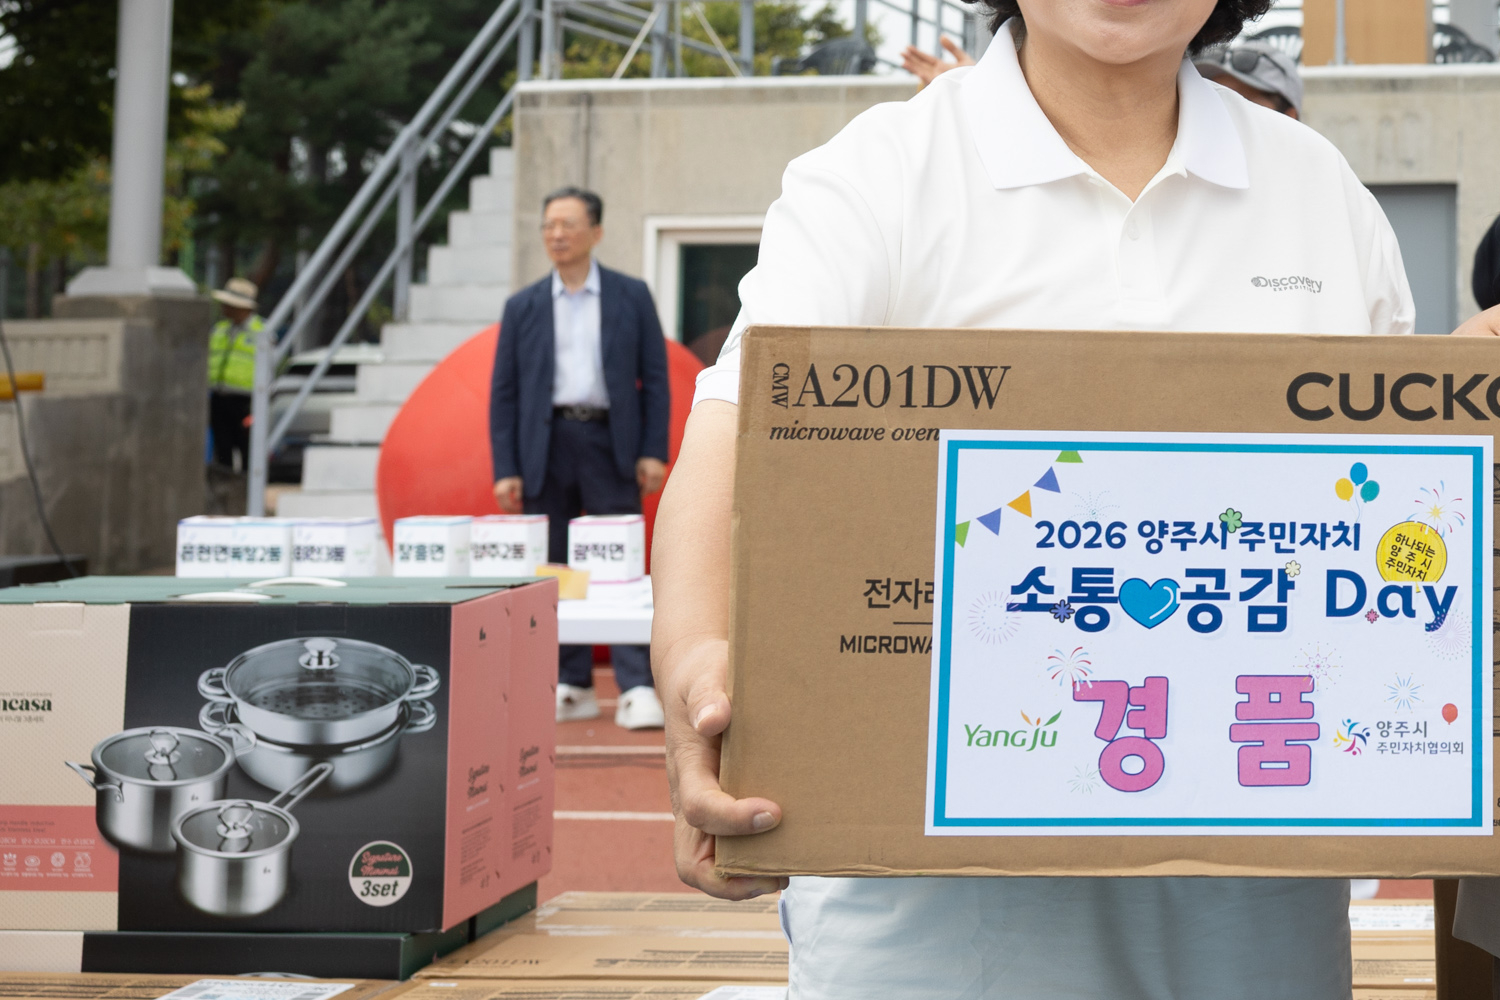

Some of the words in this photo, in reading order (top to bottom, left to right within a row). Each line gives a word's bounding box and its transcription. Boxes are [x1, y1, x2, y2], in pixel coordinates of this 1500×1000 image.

[770, 362, 791, 410] CMW
[791, 362, 1012, 410] A201DW
[769, 420, 886, 442] microwave
[891, 426, 941, 442] oven
[1034, 520, 1127, 550] 2026
[1137, 518, 1230, 555] 양주시
[1238, 521, 1362, 553] 주민자치
[1394, 532, 1436, 559] 하나되는
[1385, 557, 1428, 582] 주민자치
[1006, 565, 1120, 633] 소통
[1179, 567, 1296, 634] 공감
[1326, 569, 1459, 633] Day
[1375, 720, 1428, 738] 양주시
[1375, 741, 1464, 755] 주민자치협의회
[360, 880, 399, 897] 3set
